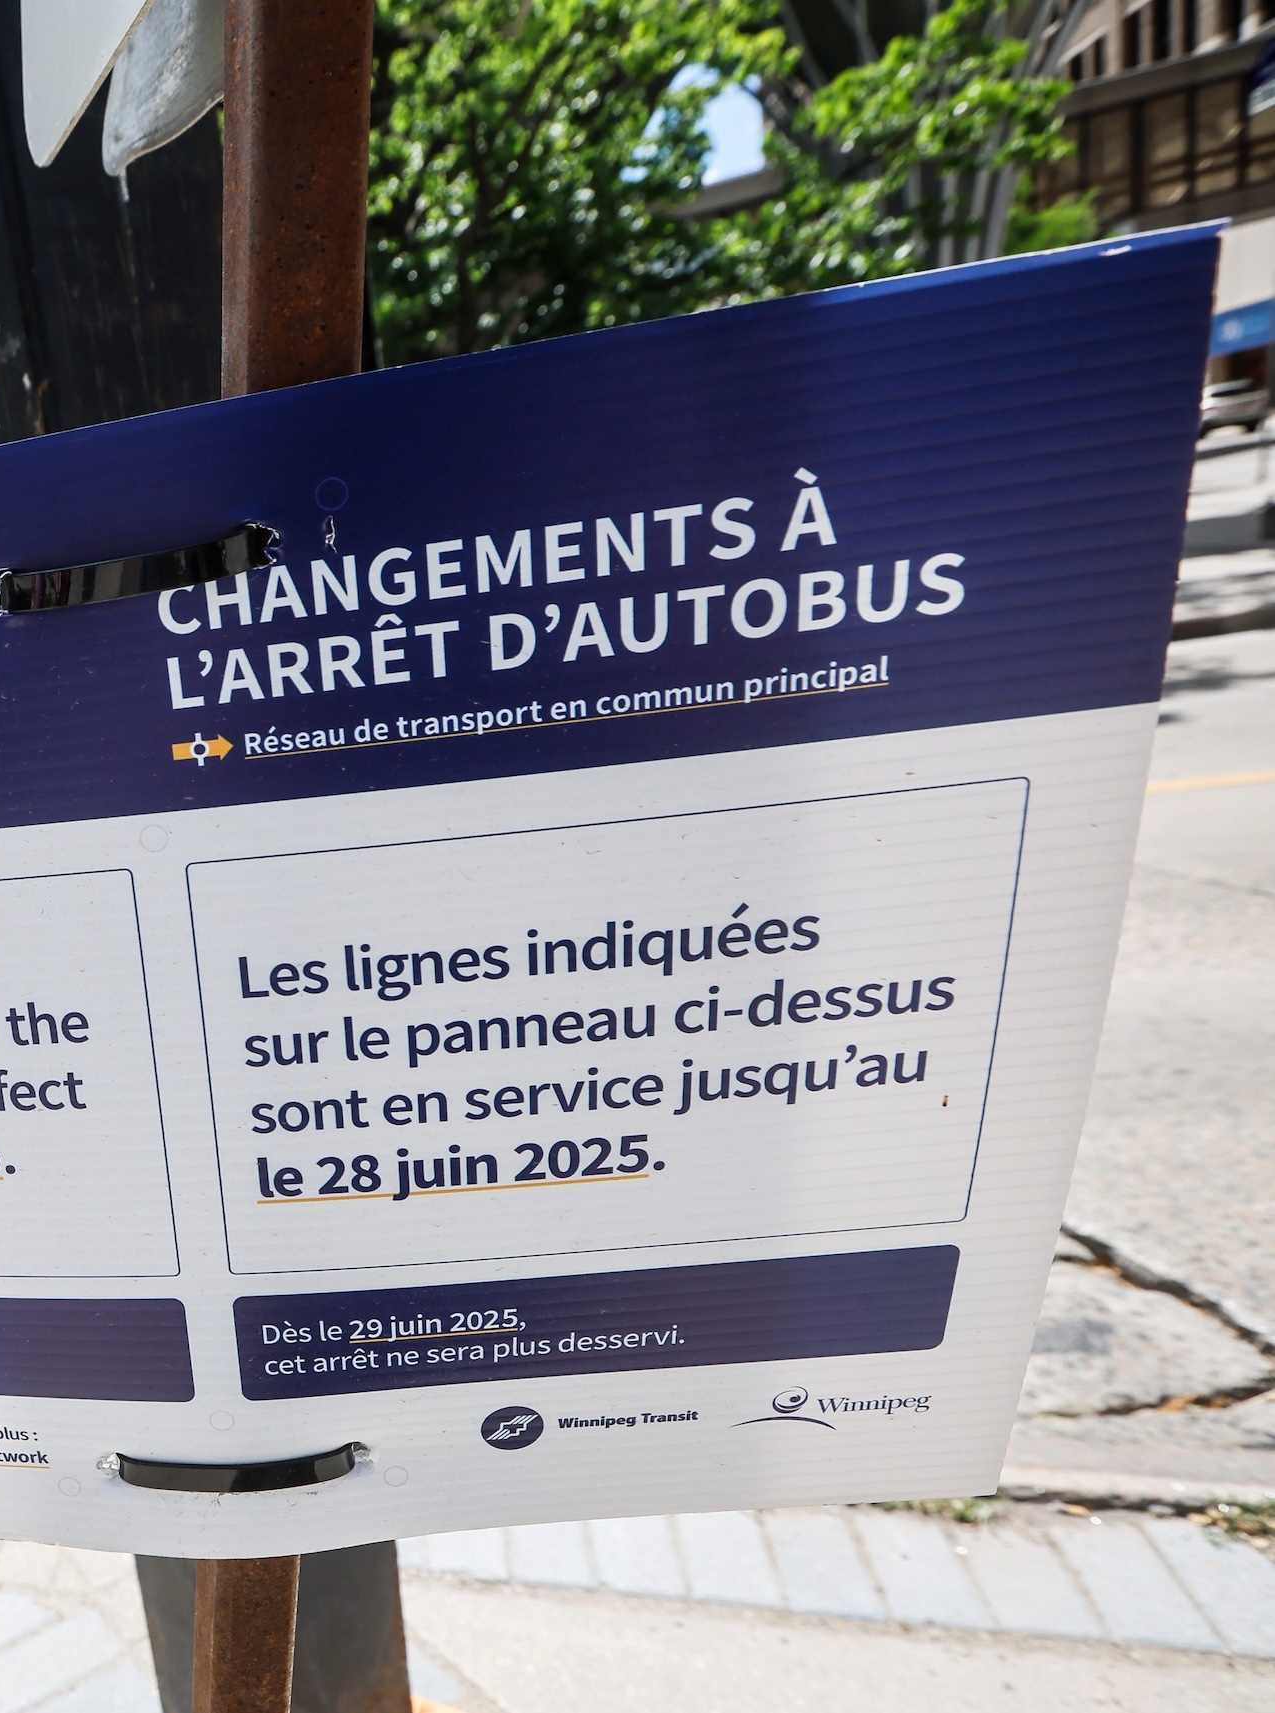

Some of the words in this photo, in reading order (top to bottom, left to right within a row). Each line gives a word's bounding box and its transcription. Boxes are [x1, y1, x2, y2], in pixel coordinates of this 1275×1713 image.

[158, 497, 756, 636] CHANGEMENTS
[780, 467, 837, 552] À
[244, 722, 347, 756] Réseau
[353, 714, 390, 744] de
[397, 700, 542, 746] transport
[551, 697, 587, 721] en
[595, 675, 733, 715] commun
[744, 655, 889, 702] principal
[239, 955, 328, 999] Les
[344, 942, 510, 1001] lignes
[527, 904, 821, 976] indiquées
[6, 1001, 89, 1045] the
[245, 1026, 328, 1068] sur
[344, 1017, 390, 1063] le
[407, 1002, 656, 1068] panneau
[675, 974, 955, 1034] ci-dessus
[251, 1093, 369, 1135] sont
[383, 1090, 448, 1127] en
[464, 1069, 664, 1121] service
[258, 1157, 304, 1198] le
[317, 1154, 380, 1197] 28
[393, 1147, 498, 1201] juin
[514, 1134, 666, 1184] 2025.
[262, 1318, 312, 1345] Dès
[318, 1319, 344, 1342] le
[348, 1318, 383, 1340] 29
[388, 1312, 443, 1342] juin
[449, 1308, 526, 1335] 2025,
[264, 1351, 307, 1376] cet
[312, 1346, 380, 1372] arrêt
[385, 1346, 421, 1366] ne
[426, 1340, 486, 1363] sera
[493, 1333, 553, 1363] plus
[558, 1324, 685, 1353] desservi.
[558, 1415, 637, 1431] Winnipeg
[642, 1408, 699, 1425] Transit
[815, 1391, 931, 1415] Winnipeg
